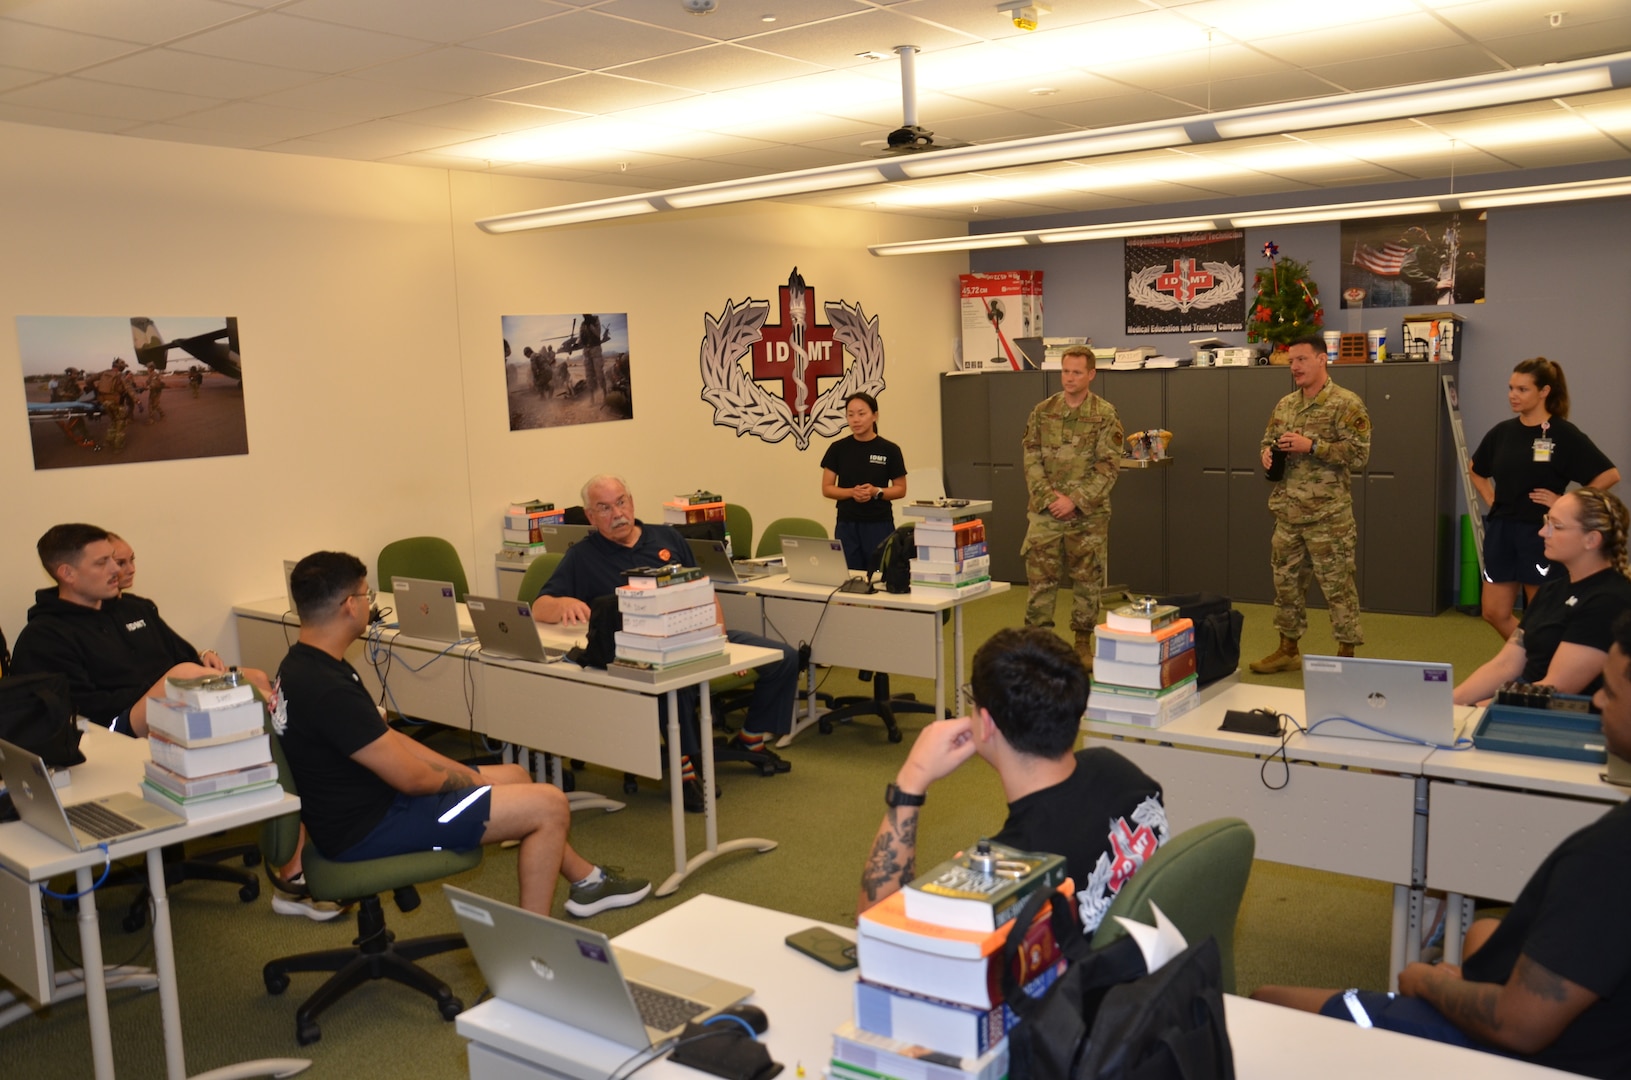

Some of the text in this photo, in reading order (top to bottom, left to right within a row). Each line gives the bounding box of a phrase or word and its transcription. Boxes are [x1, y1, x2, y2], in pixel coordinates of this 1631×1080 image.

[1126, 231, 1243, 246] Independent Duty Medical Technician
[1127, 322, 1243, 334] Medical Education and Training Campus
[125, 618, 147, 632] IDMT
